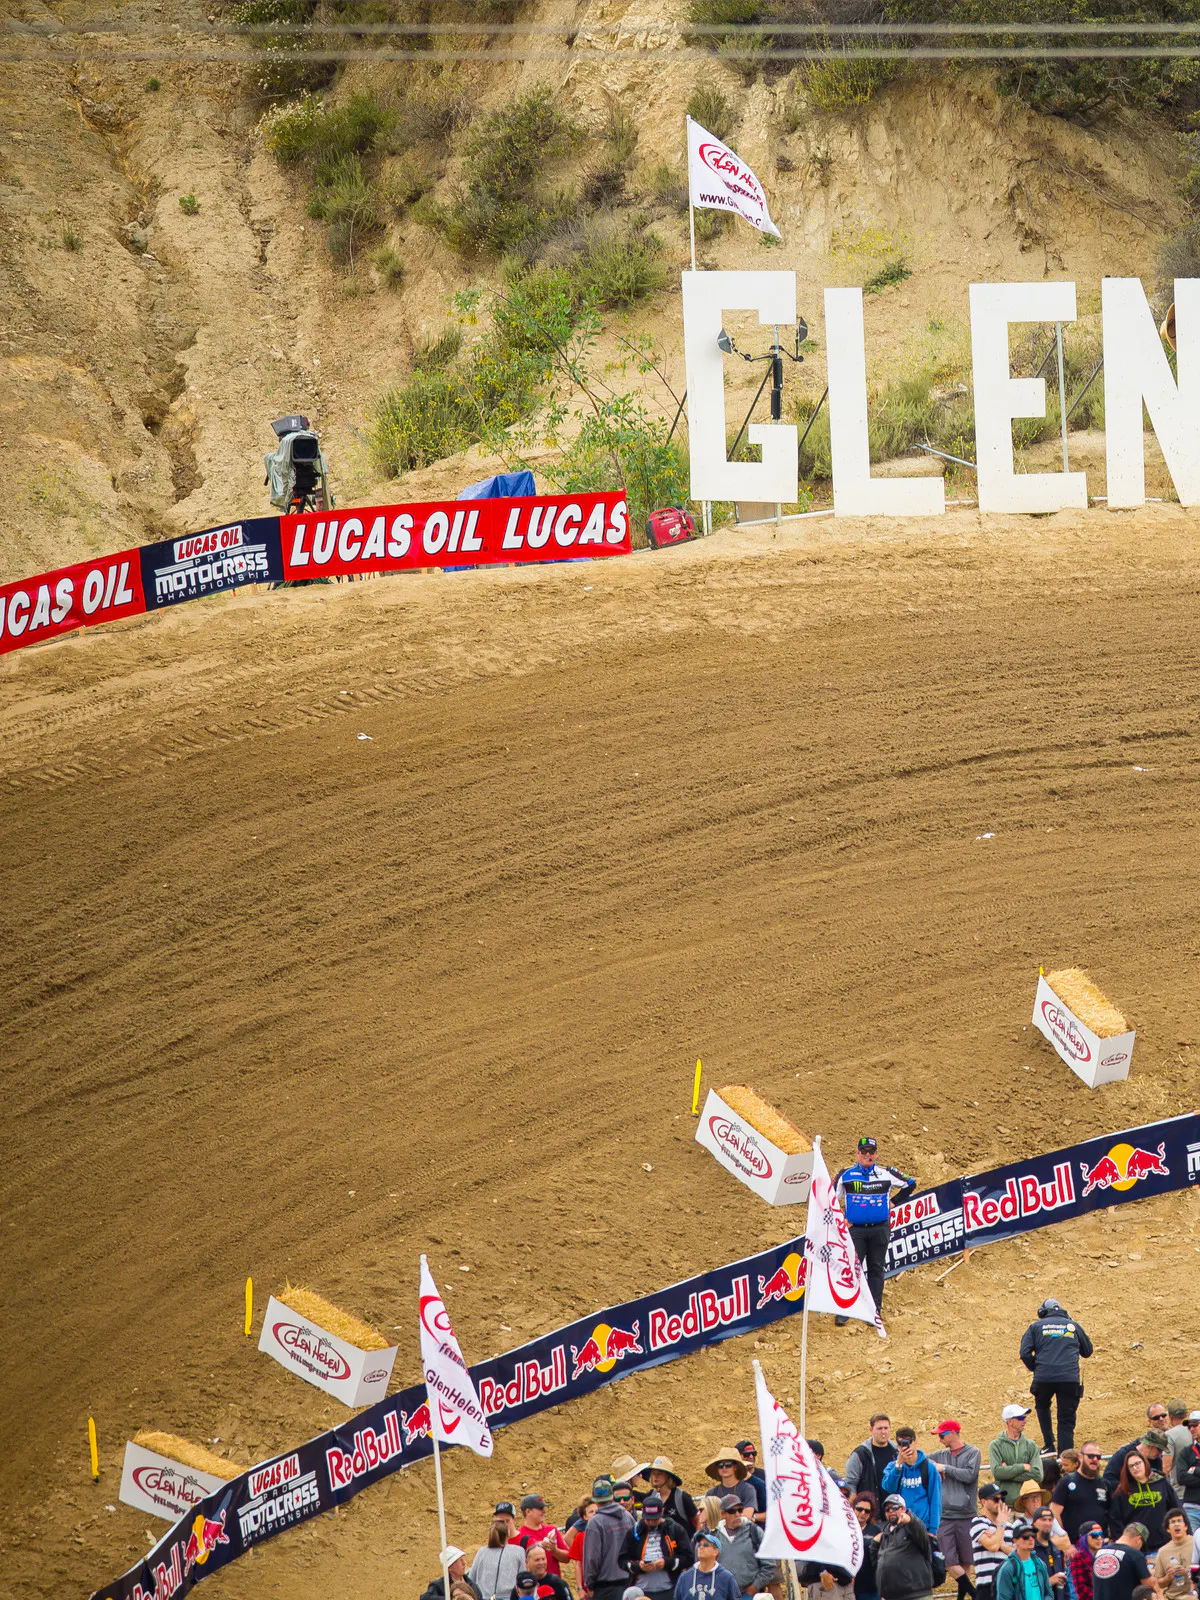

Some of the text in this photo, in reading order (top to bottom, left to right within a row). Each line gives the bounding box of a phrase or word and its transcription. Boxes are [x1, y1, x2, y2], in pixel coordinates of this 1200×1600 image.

[177, 529, 241, 560] LUCAS OIL
[289, 500, 628, 567] LUCAS OIL LUCAS
[155, 551, 269, 596] MOTOCROSS
[195, 552, 226, 566] PRO
[0, 561, 134, 639] CAS OIL
[156, 570, 271, 604] CHAMPIONSHIP
[889, 1195, 936, 1230] CAS OIL
[884, 1217, 964, 1264] TOCROSS
[889, 1222, 922, 1241] PRO
[884, 1240, 960, 1273] MPIONSHI
[284, 1327, 341, 1373] GLEN HELEN
[146, 1470, 176, 1497] GLEN
[252, 1456, 299, 1496] LUCAS OIL
[262, 1484, 289, 1501] PRO
[239, 1480, 320, 1538] MOTOCROSS
[243, 1501, 322, 1548] CHAMPIONSHIP
